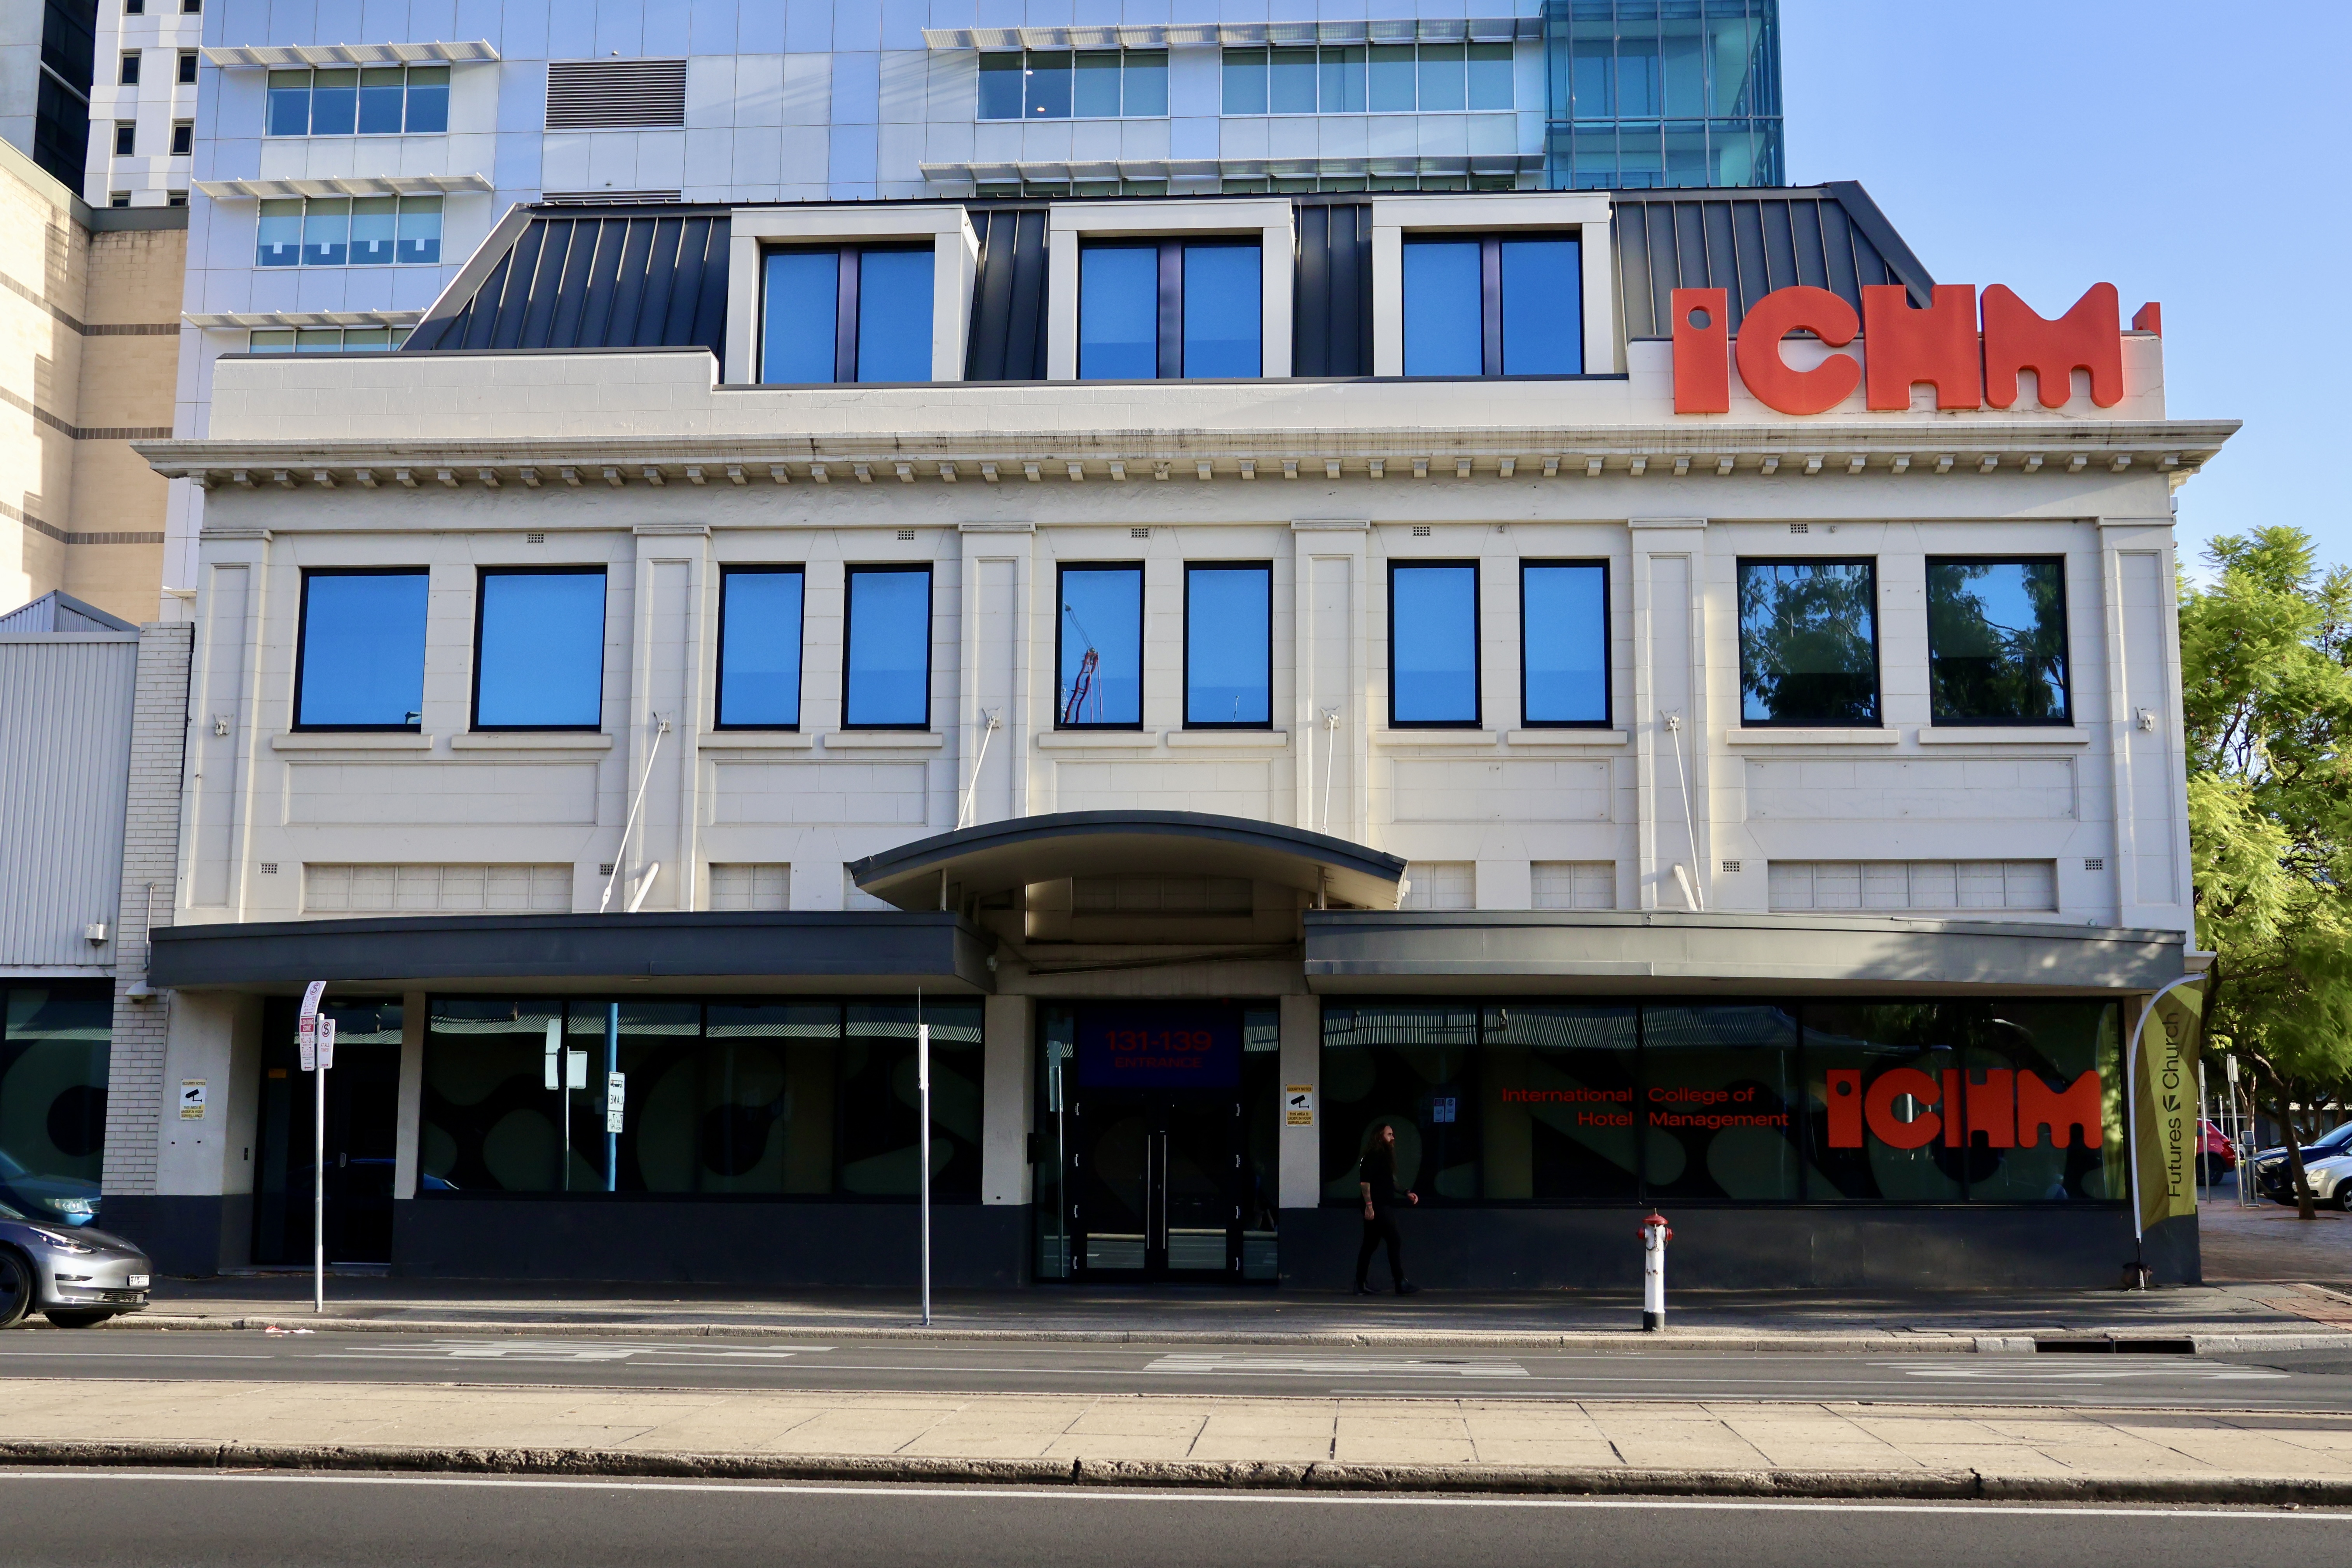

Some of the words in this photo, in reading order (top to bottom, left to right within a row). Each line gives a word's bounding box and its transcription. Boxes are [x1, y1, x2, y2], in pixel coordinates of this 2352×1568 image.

[1105, 1030, 1212, 1051] 131-139
[2162, 1013, 2179, 1089] Church
[1115, 1057, 1203, 1068] ENTRANCE
[1502, 1088, 1632, 1102] International
[1648, 1088, 1728, 1104] College
[1733, 1088, 1755, 1102] of
[1578, 1112, 1632, 1126] Hotel
[1649, 1112, 1788, 1129] Management
[2168, 1118, 2181, 1196] Futures
